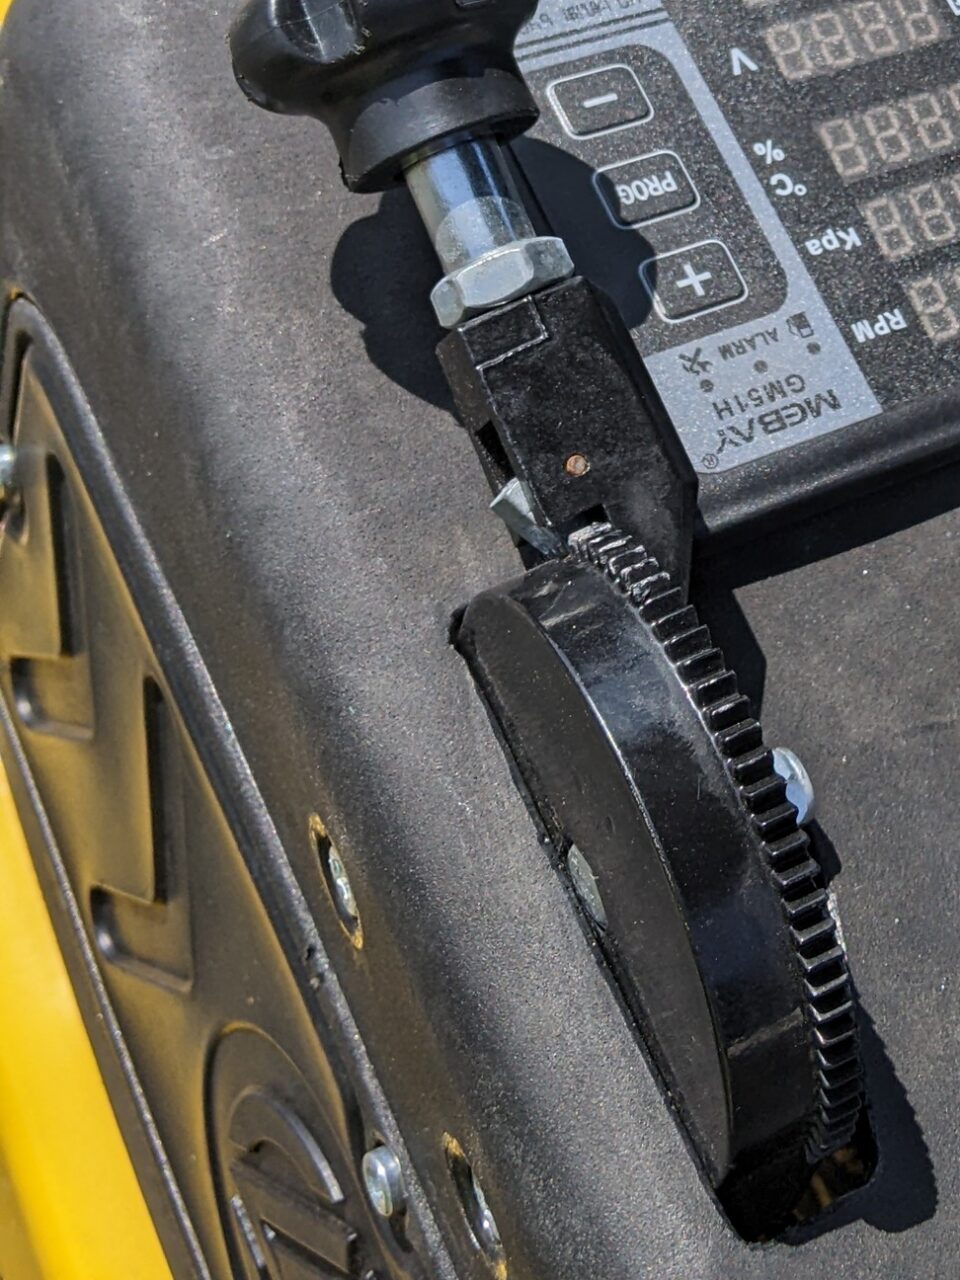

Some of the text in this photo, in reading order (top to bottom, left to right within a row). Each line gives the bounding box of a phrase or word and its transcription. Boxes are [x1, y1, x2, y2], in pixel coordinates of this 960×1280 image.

[730, 47, 759, 76] V
[753, 139, 785, 164] %
[614, 171, 678, 205] PROG
[805, 227, 862, 256] Kpa
[851, 308, 908, 343] RPM
[718, 327, 779, 361] ALARM
[712, 374, 806, 420] GM51H
